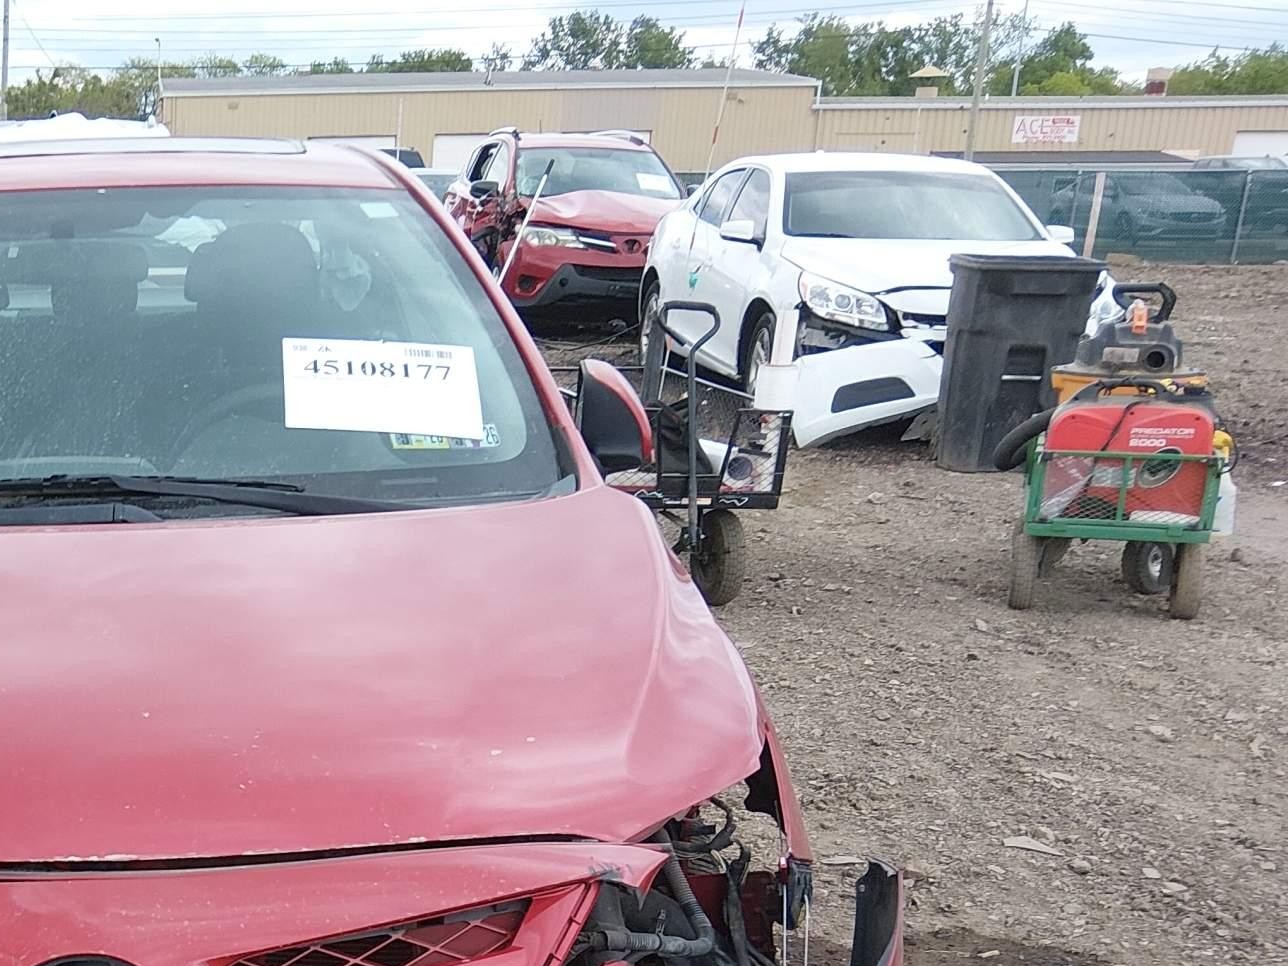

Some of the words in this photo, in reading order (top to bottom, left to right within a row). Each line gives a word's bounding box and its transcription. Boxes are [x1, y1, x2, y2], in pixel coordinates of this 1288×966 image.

[1015, 118, 1050, 135] ACE
[303, 359, 451, 381] 45108177
[482, 423, 500, 445] 26
[1130, 427, 1196, 435] PREDATOR
